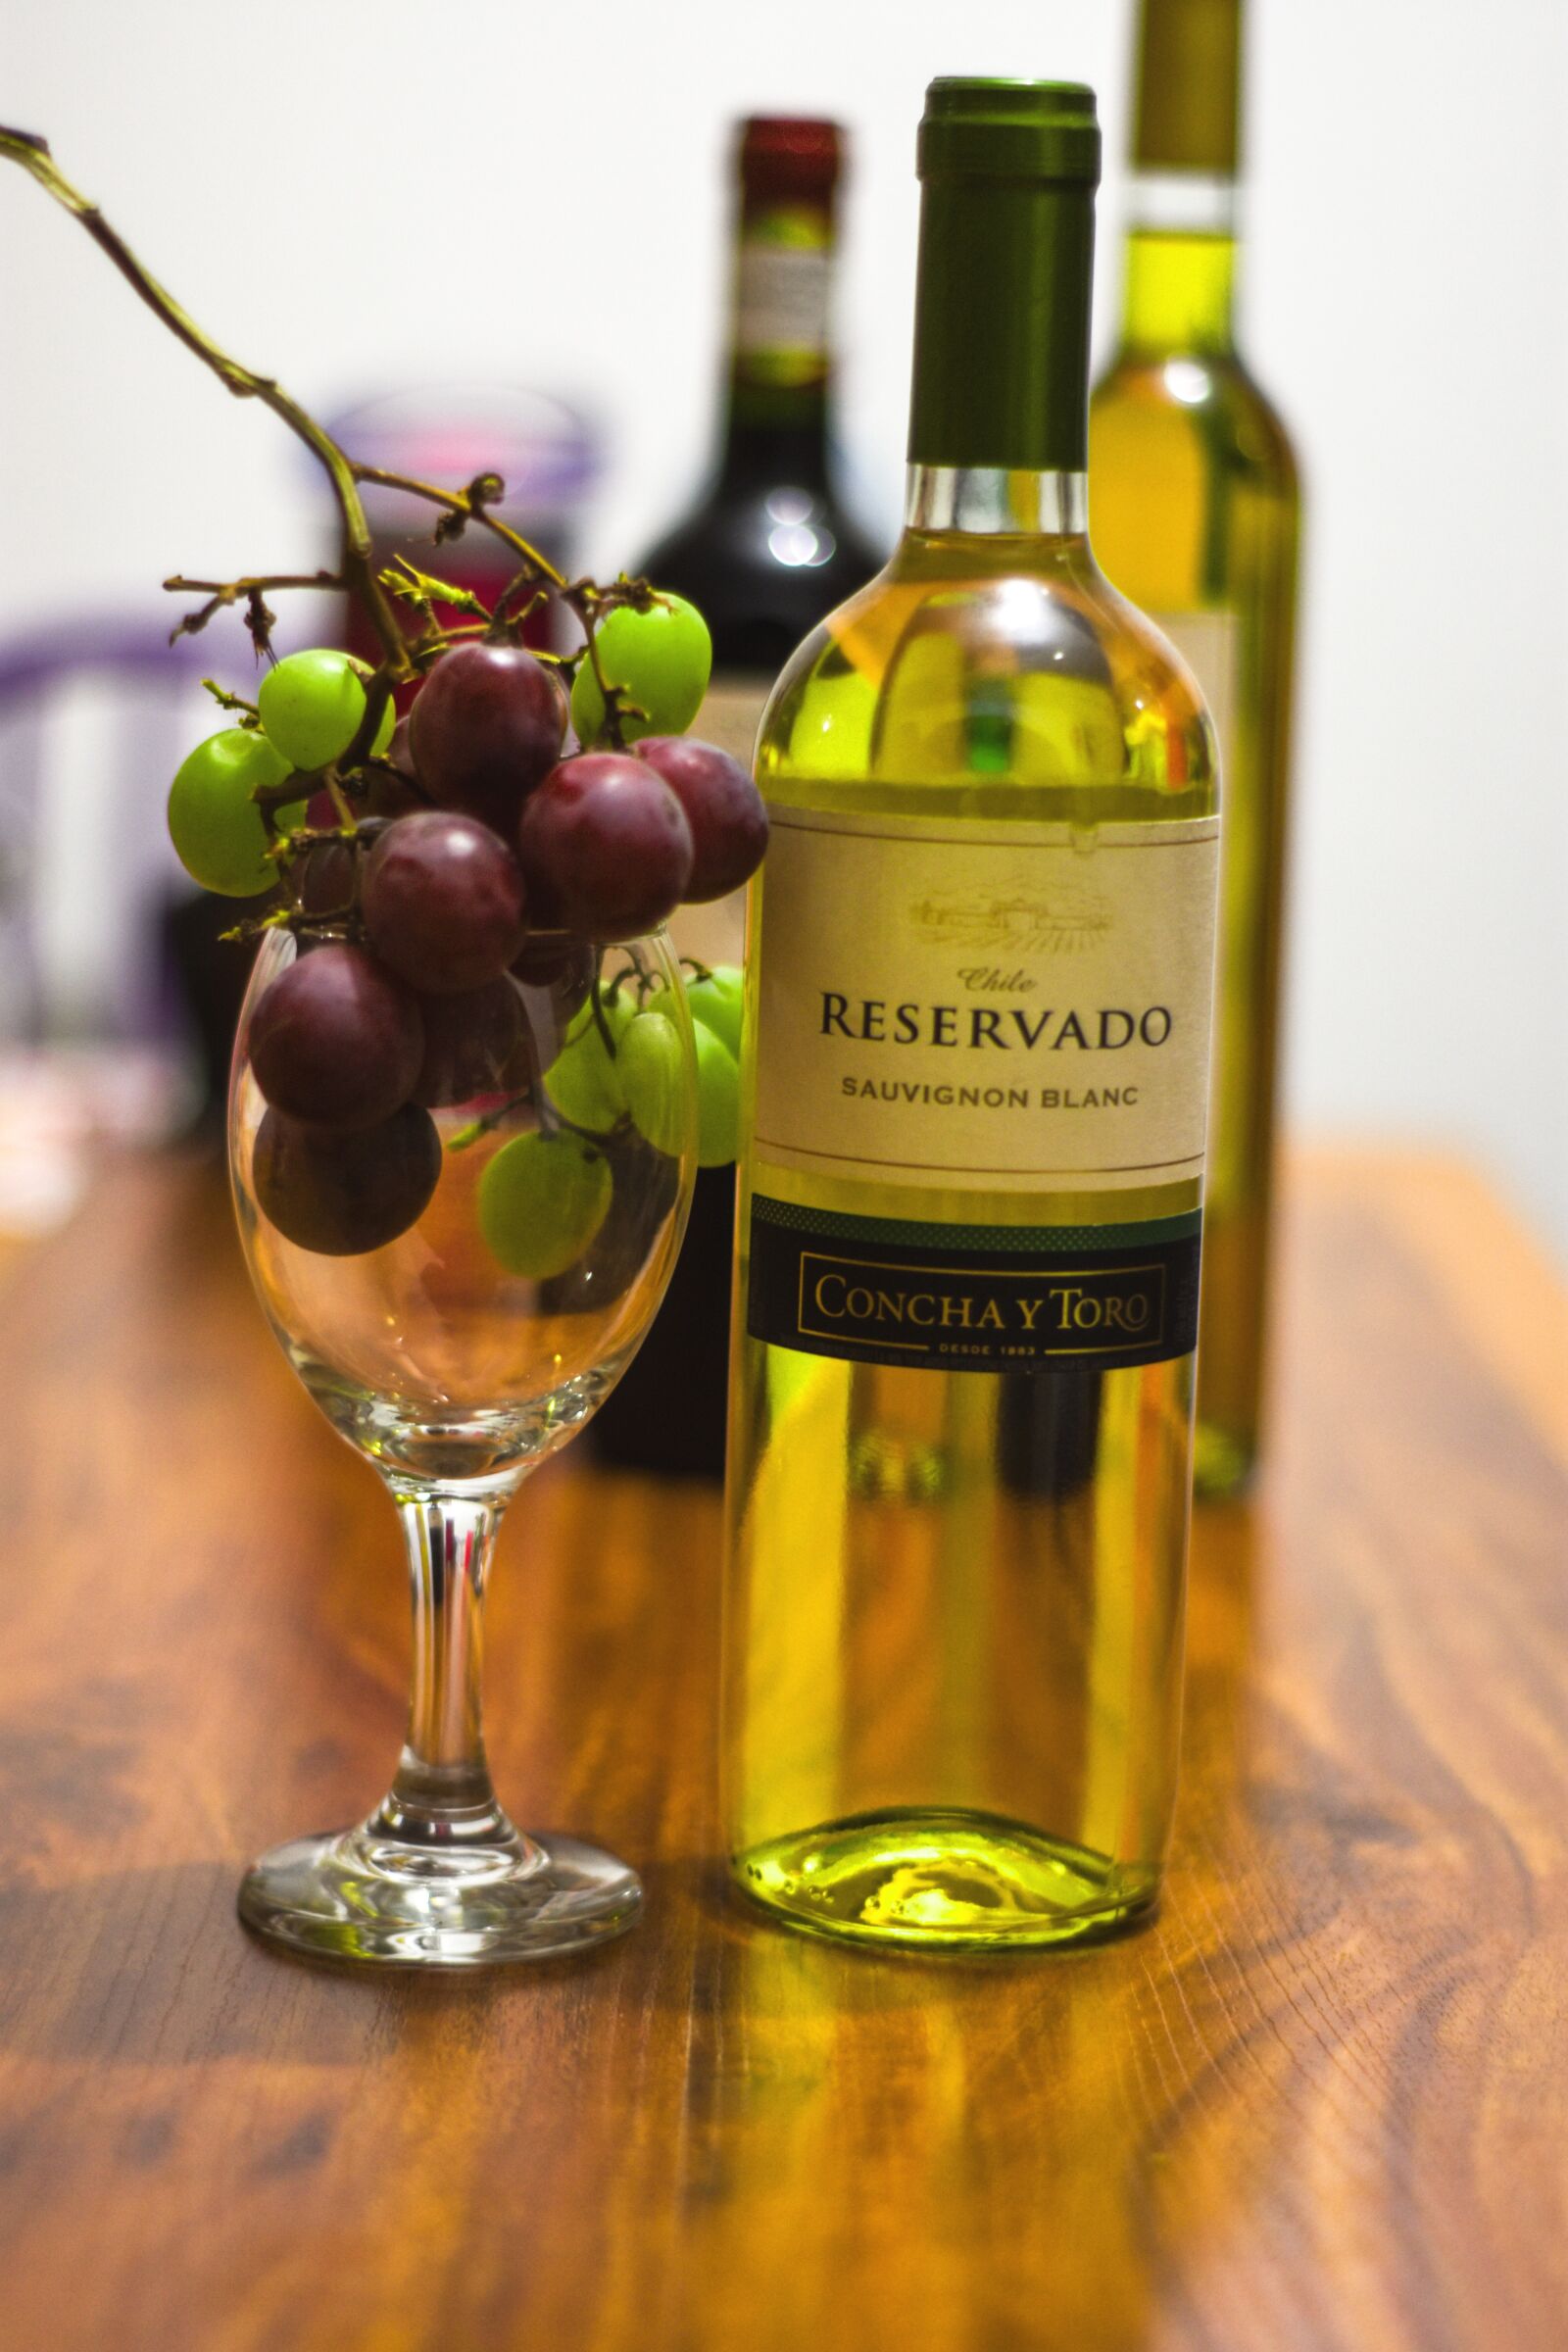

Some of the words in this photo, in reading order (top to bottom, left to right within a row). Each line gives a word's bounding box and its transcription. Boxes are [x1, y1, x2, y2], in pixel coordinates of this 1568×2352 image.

[956, 966, 1037, 993] Chile
[819, 991, 1173, 1051] RESERVADO
[841, 1077, 1028, 1108] SAUVIGNON
[1041, 1087, 1139, 1108] BLANC
[814, 1274, 1006, 1330] CONCHA
[1016, 1299, 1045, 1329] Y
[1049, 1289, 1151, 1332] TORO
[939, 1344, 990, 1355] DESDE
